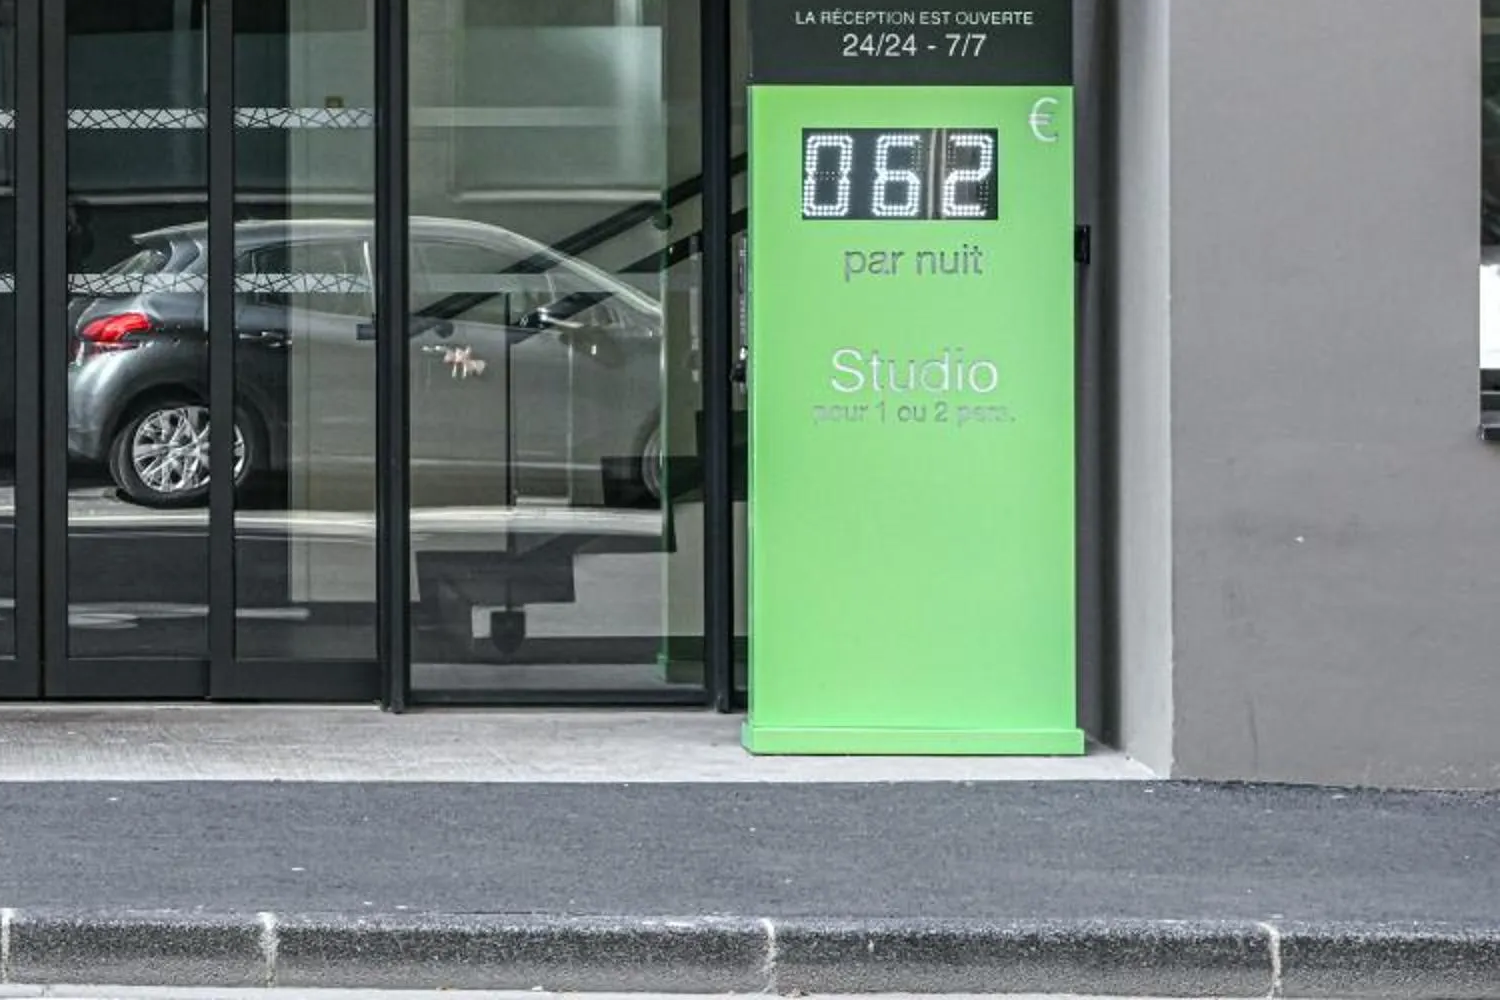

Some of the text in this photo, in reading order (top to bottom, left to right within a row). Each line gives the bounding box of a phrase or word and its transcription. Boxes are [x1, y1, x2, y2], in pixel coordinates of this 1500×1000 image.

[795, 7, 1034, 26] LA RÉCEPTION EST OUVERTE
[841, 33, 918, 58] 24/24
[944, 33, 988, 58] 7/7
[1028, 96, 1060, 143] €
[802, 134, 995, 218] 062
[843, 242, 984, 283] par nuit
[830, 347, 1000, 394] Studio
[897, 404, 927, 424] ou
[934, 401, 950, 423] 2
